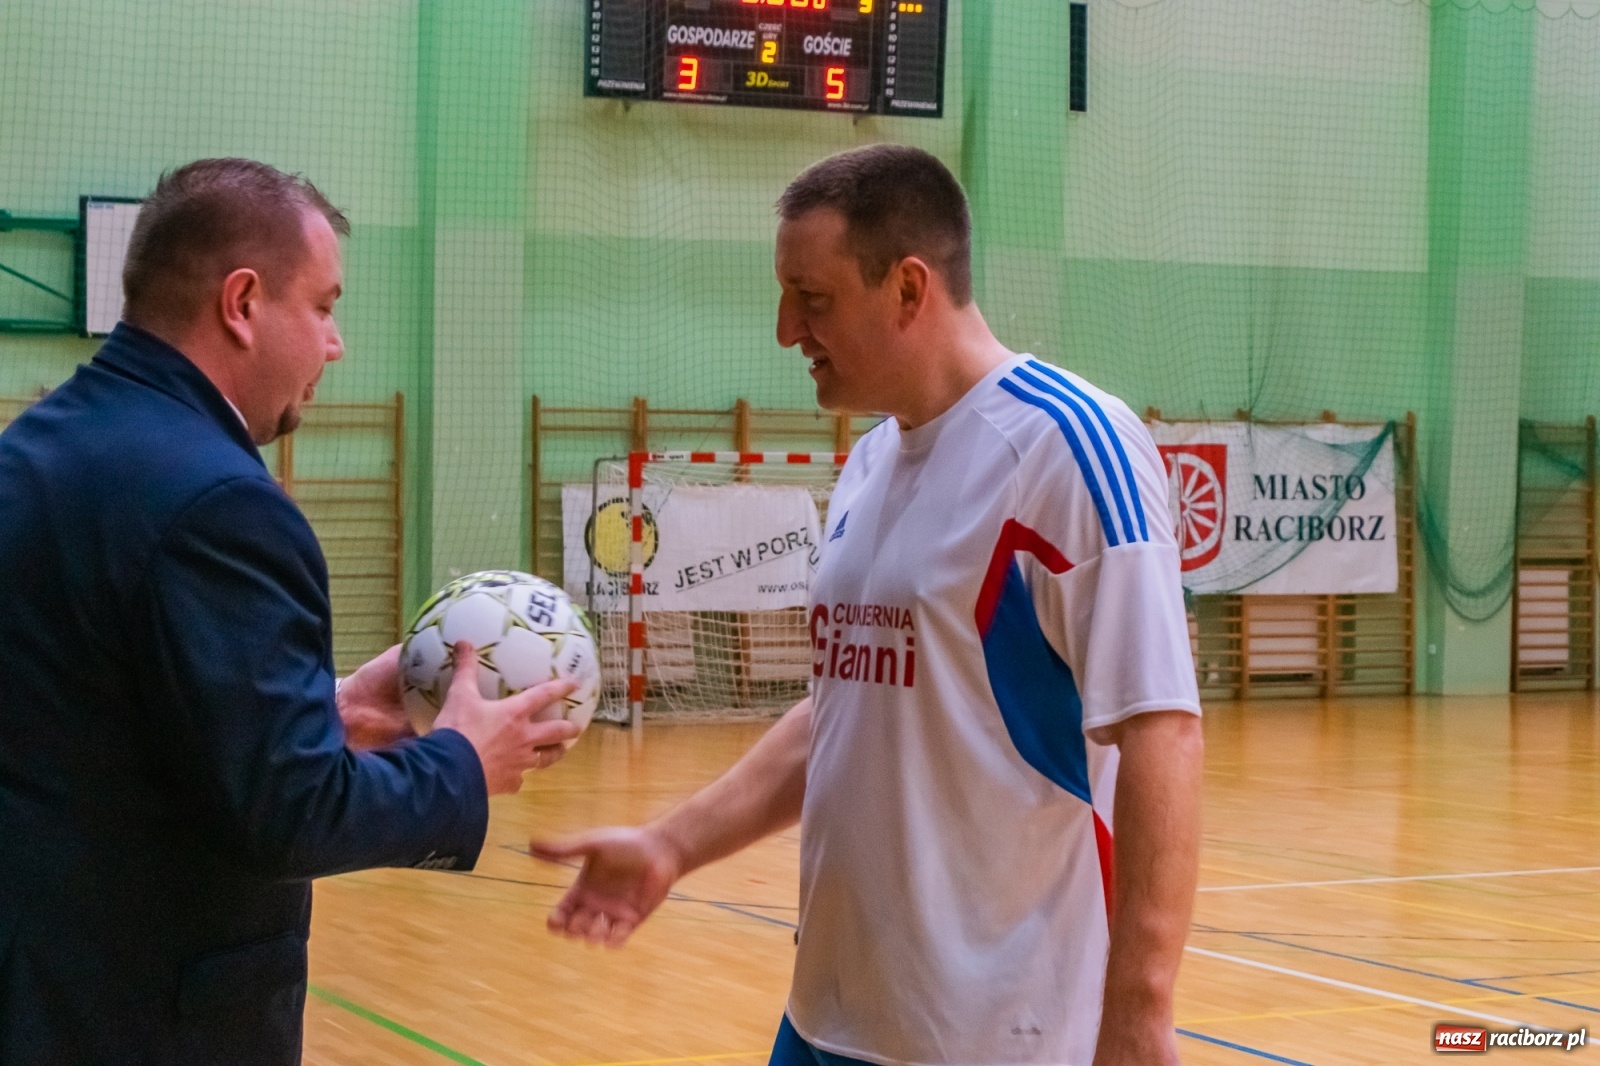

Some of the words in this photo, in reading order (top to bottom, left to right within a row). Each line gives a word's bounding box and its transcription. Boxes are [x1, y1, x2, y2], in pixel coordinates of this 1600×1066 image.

[667, 24, 756, 49] GOSPODARZE
[889, 23, 896, 32] 9
[761, 41, 777, 64] 2
[803, 31, 852, 57] GOŚCIE
[678, 57, 698, 90] 3
[745, 71, 768, 87] 3D
[826, 67, 844, 99] 5
[1253, 474, 1366, 501] MIASTO
[675, 556, 724, 588] JEST
[730, 548, 751, 569] W
[810, 604, 915, 687] Gianni
